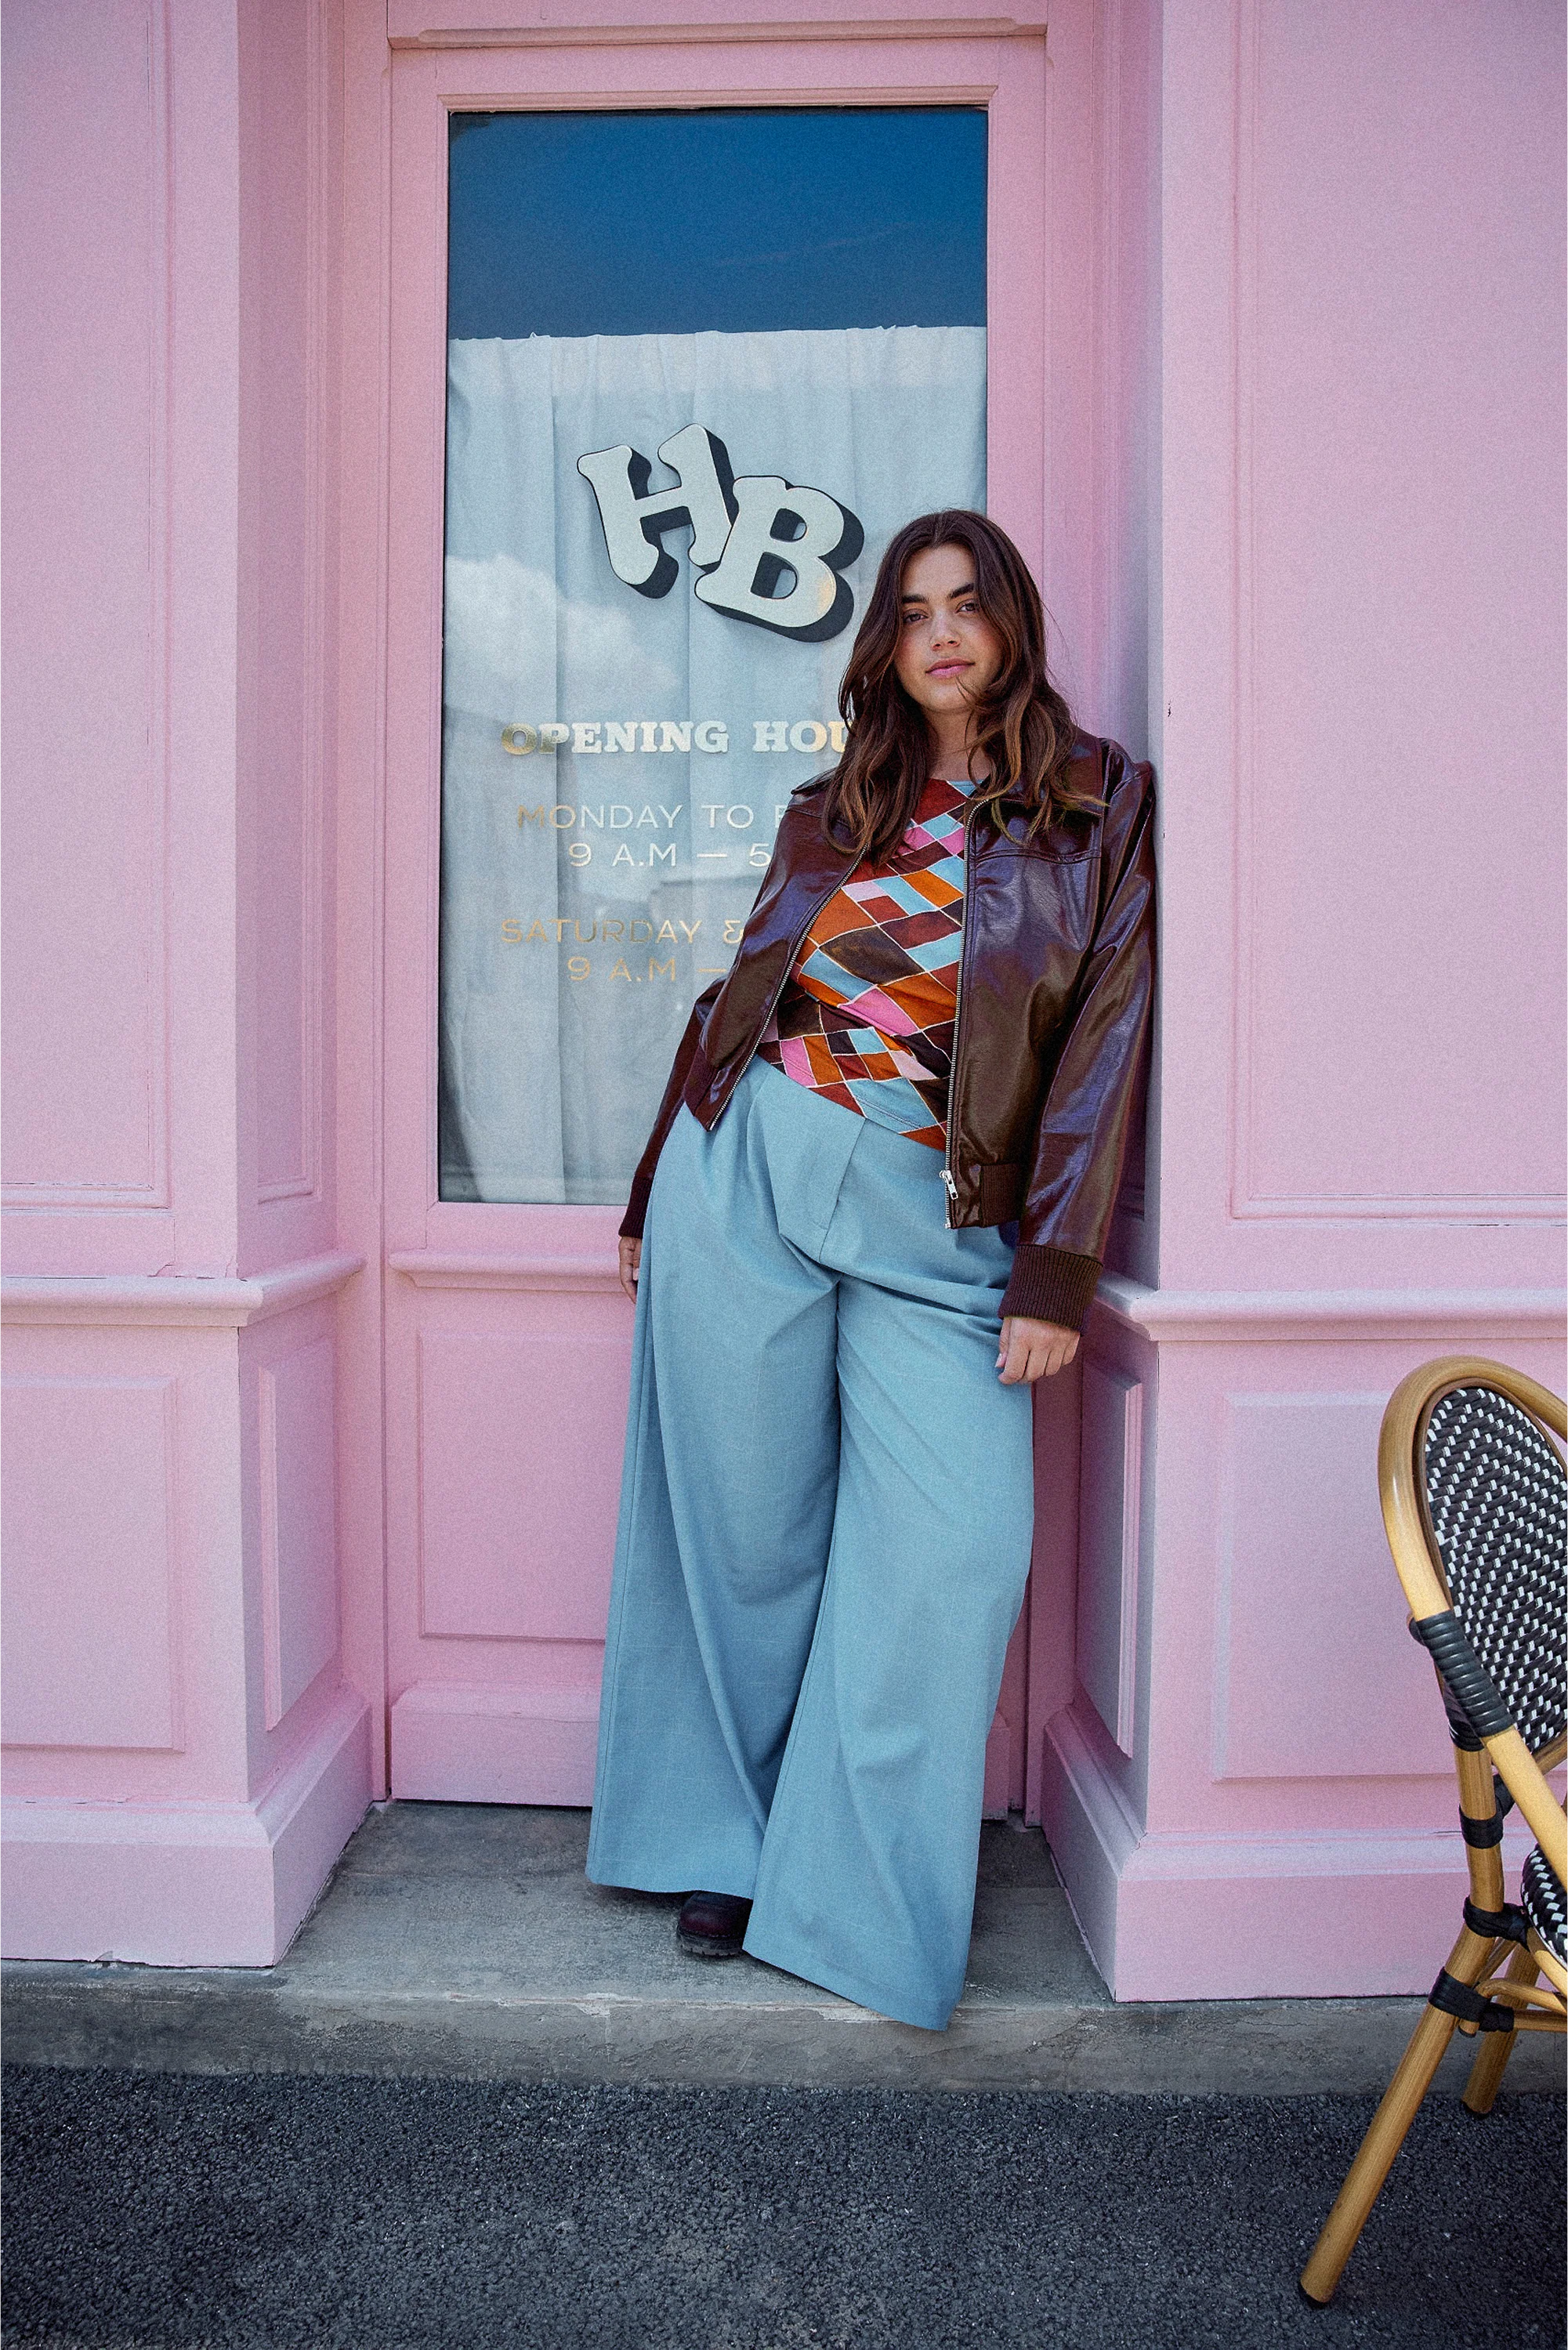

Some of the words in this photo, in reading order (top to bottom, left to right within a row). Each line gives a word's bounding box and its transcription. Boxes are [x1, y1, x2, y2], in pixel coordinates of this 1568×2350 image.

[577, 423, 864, 643] HB
[501, 721, 729, 755] OPENING
[517, 805, 682, 829] MONDAY
[701, 804, 754, 829] TO
[568, 843, 592, 867] 9
[612, 843, 676, 867] A.M
[749, 842, 772, 867] 5
[501, 919, 702, 943] SATURDAY
[722, 919, 744, 944] &
[567, 956, 591, 981] 9
[609, 958, 676, 982] A.M
